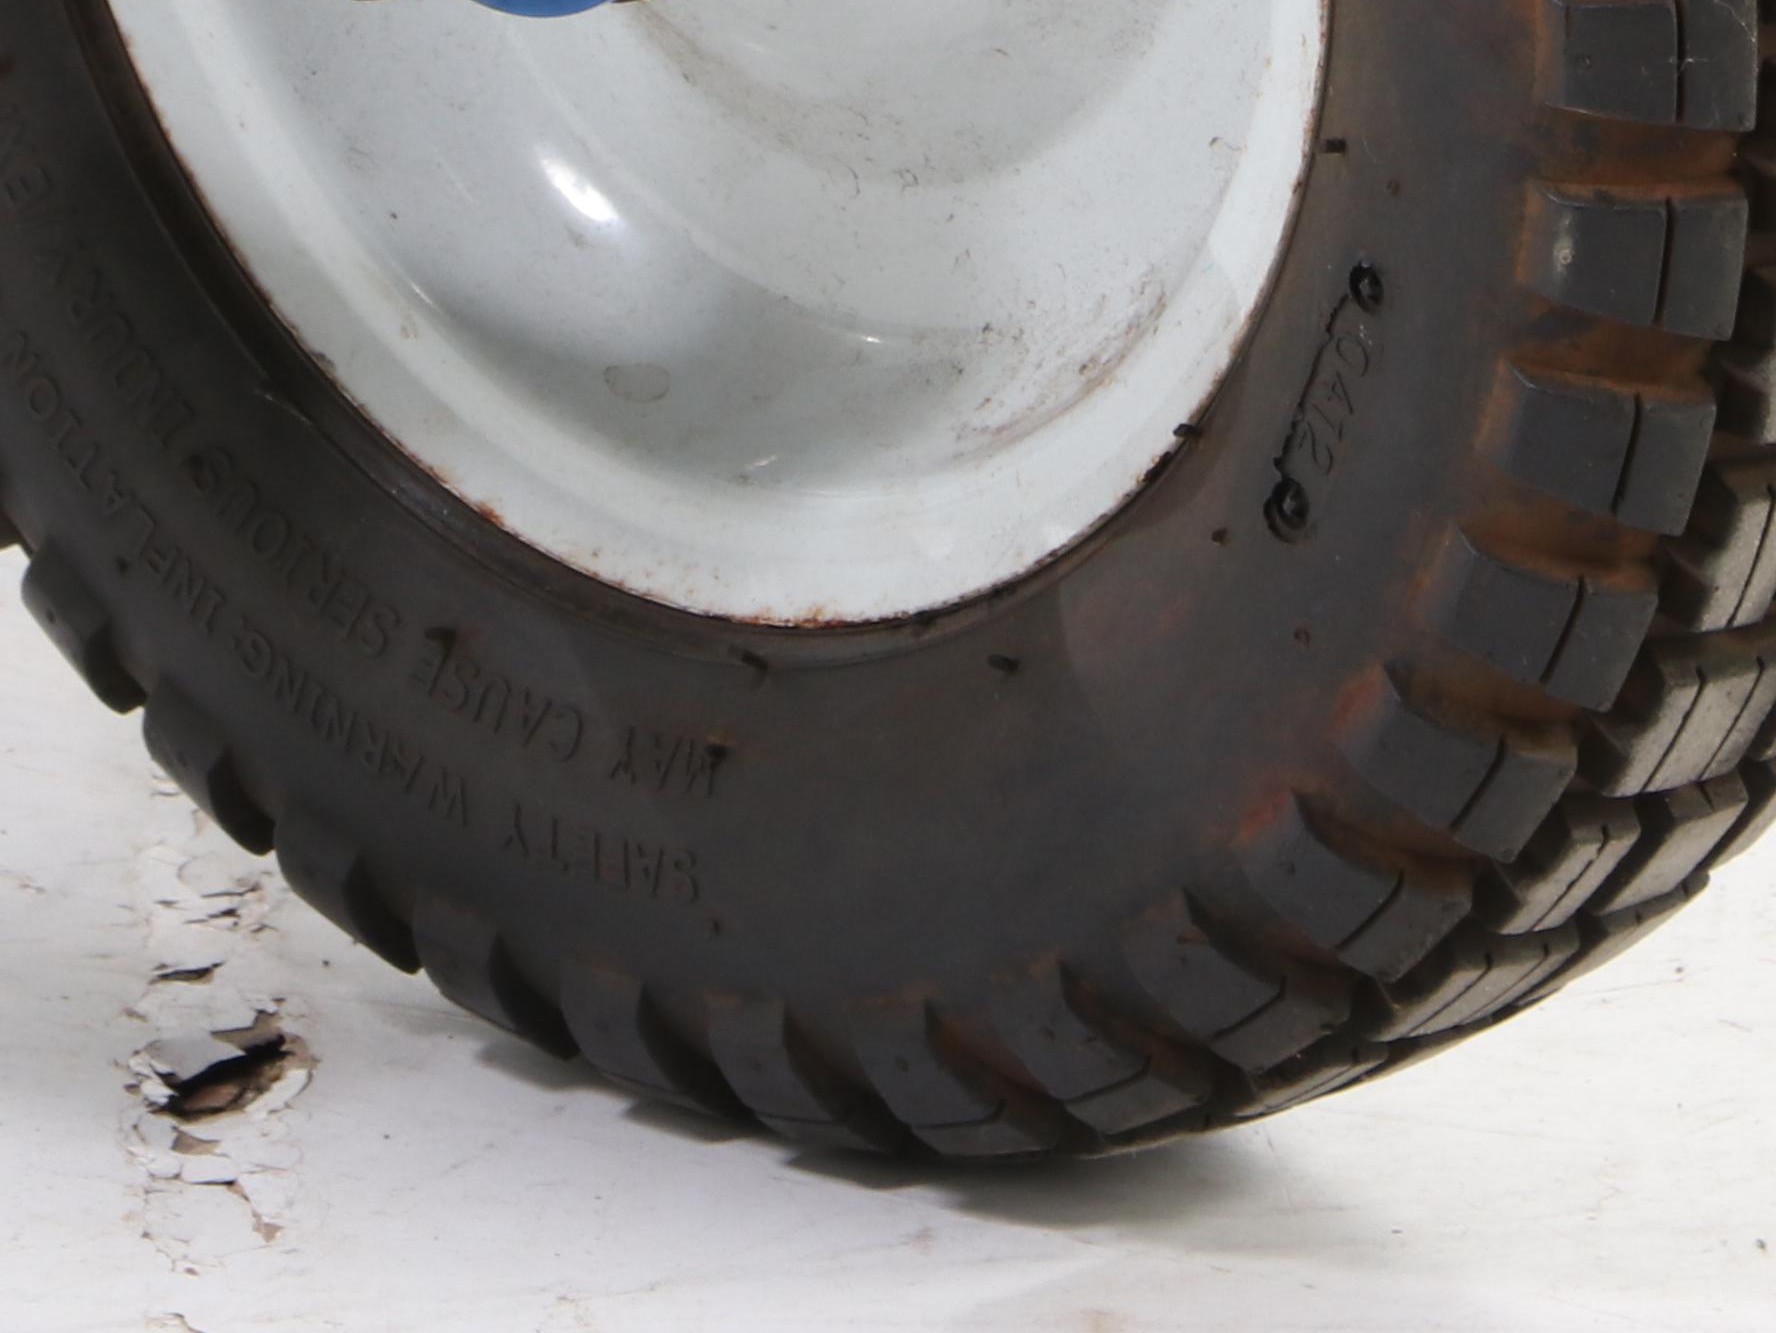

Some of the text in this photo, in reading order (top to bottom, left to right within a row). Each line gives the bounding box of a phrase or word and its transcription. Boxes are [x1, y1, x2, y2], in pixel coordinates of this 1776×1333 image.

[182, 443, 403, 662] SERIOUS
[408, 638, 586, 765] CAUSE
[605, 724, 726, 803] MAY
[499, 801, 704, 910] SAFETY
